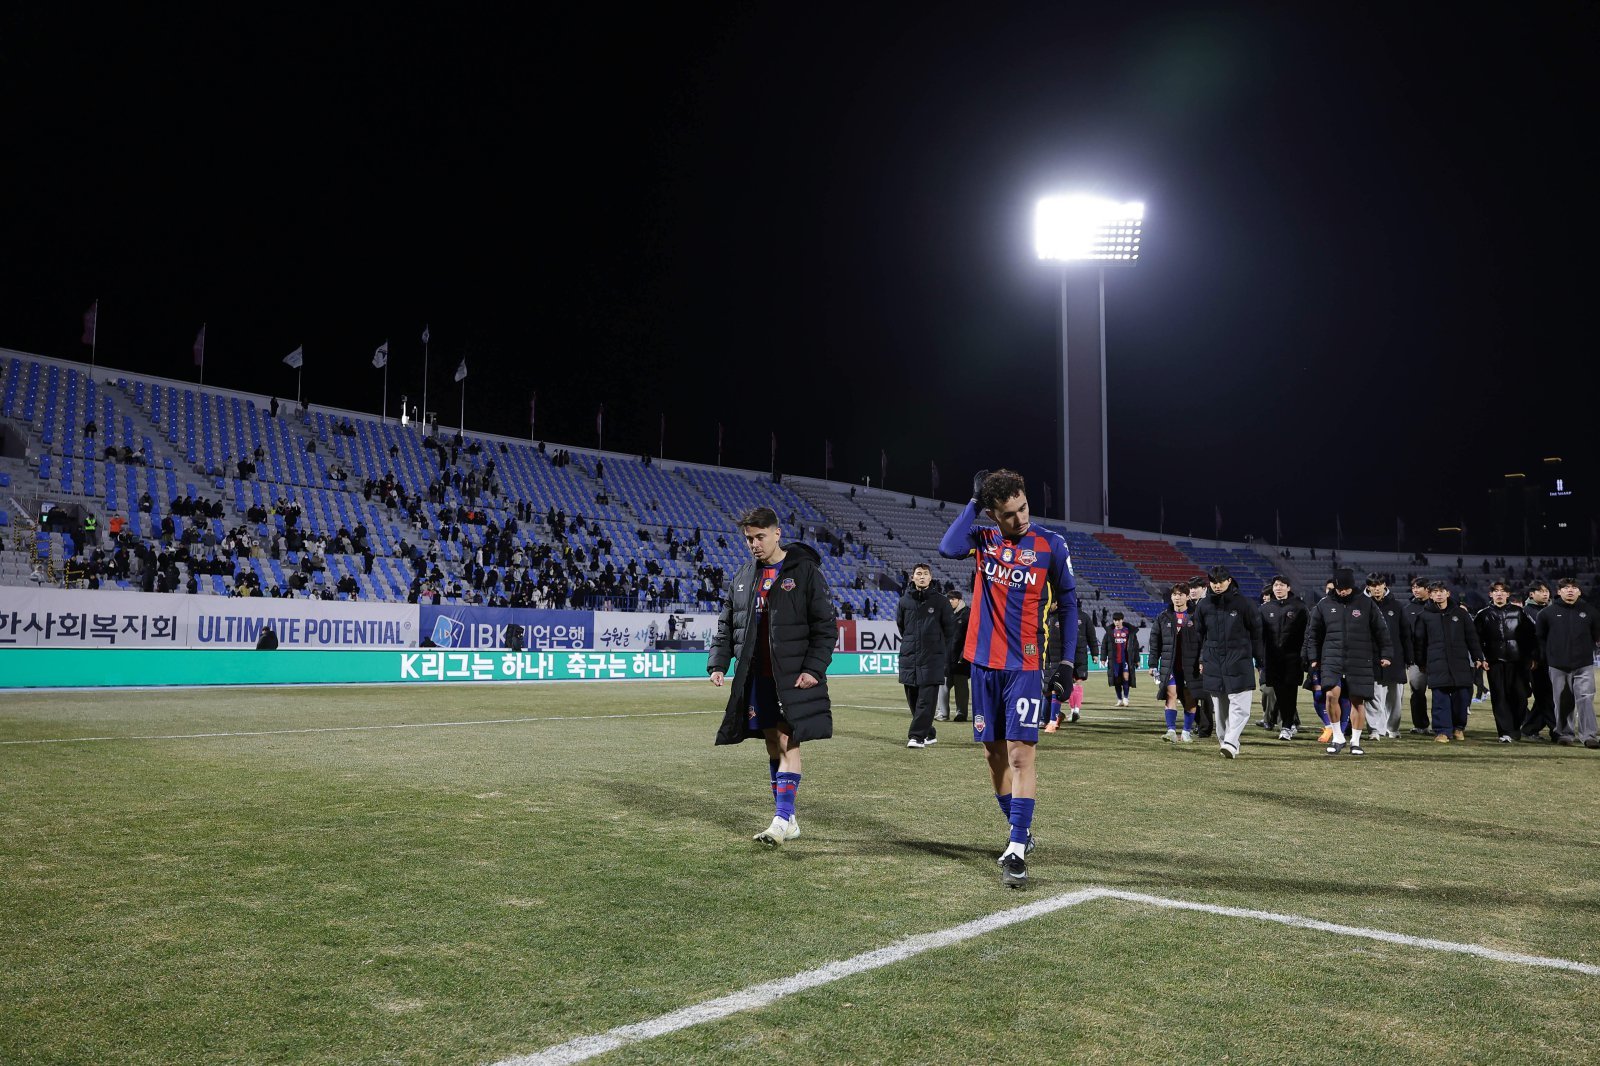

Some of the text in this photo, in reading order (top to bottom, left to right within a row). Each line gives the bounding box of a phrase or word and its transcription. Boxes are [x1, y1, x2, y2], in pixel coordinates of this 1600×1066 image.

[979, 561, 1037, 586] UWON
[986, 575, 1021, 589] PECIAL CITY
[0, 610, 177, 644] 한사회복지회
[304, 619, 404, 644] POTENTIAL
[600, 627, 630, 647] 수원을
[400, 652, 676, 680] K리그는 하나! 축구는 하나!
[1016, 697, 1040, 723] 97
